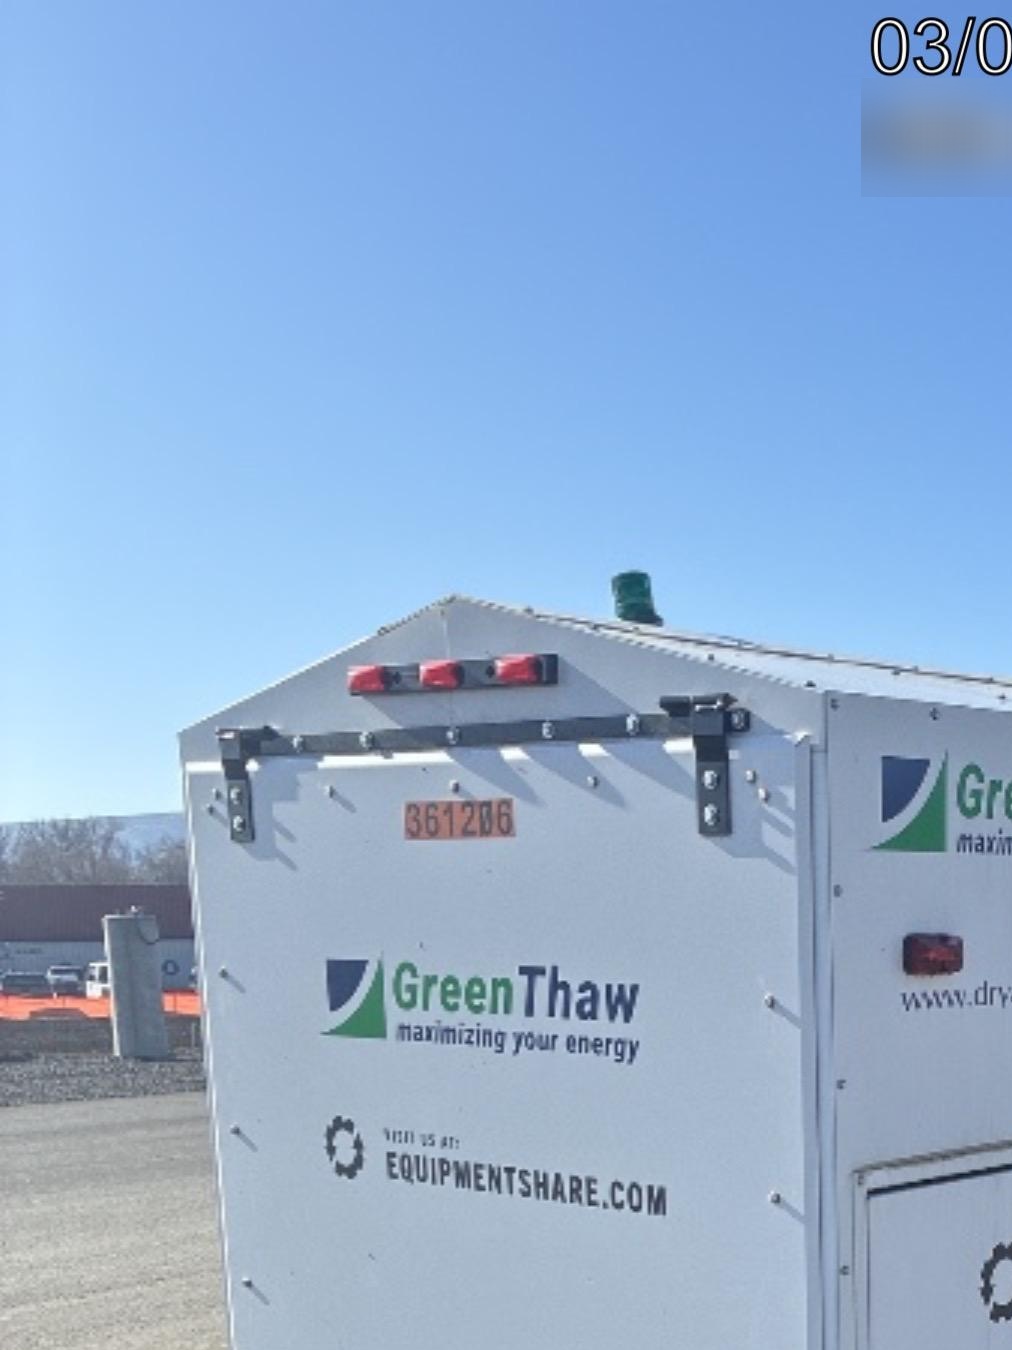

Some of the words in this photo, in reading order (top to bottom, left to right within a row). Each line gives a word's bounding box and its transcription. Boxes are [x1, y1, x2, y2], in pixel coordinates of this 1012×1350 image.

[392, 960, 641, 1024] GreenThaw
[396, 1020, 507, 1054] maximizing
[512, 1031, 559, 1056] your
[565, 1036, 641, 1065] energy
[386, 1151, 668, 1216] EQUIPMENTSHARE.COM
